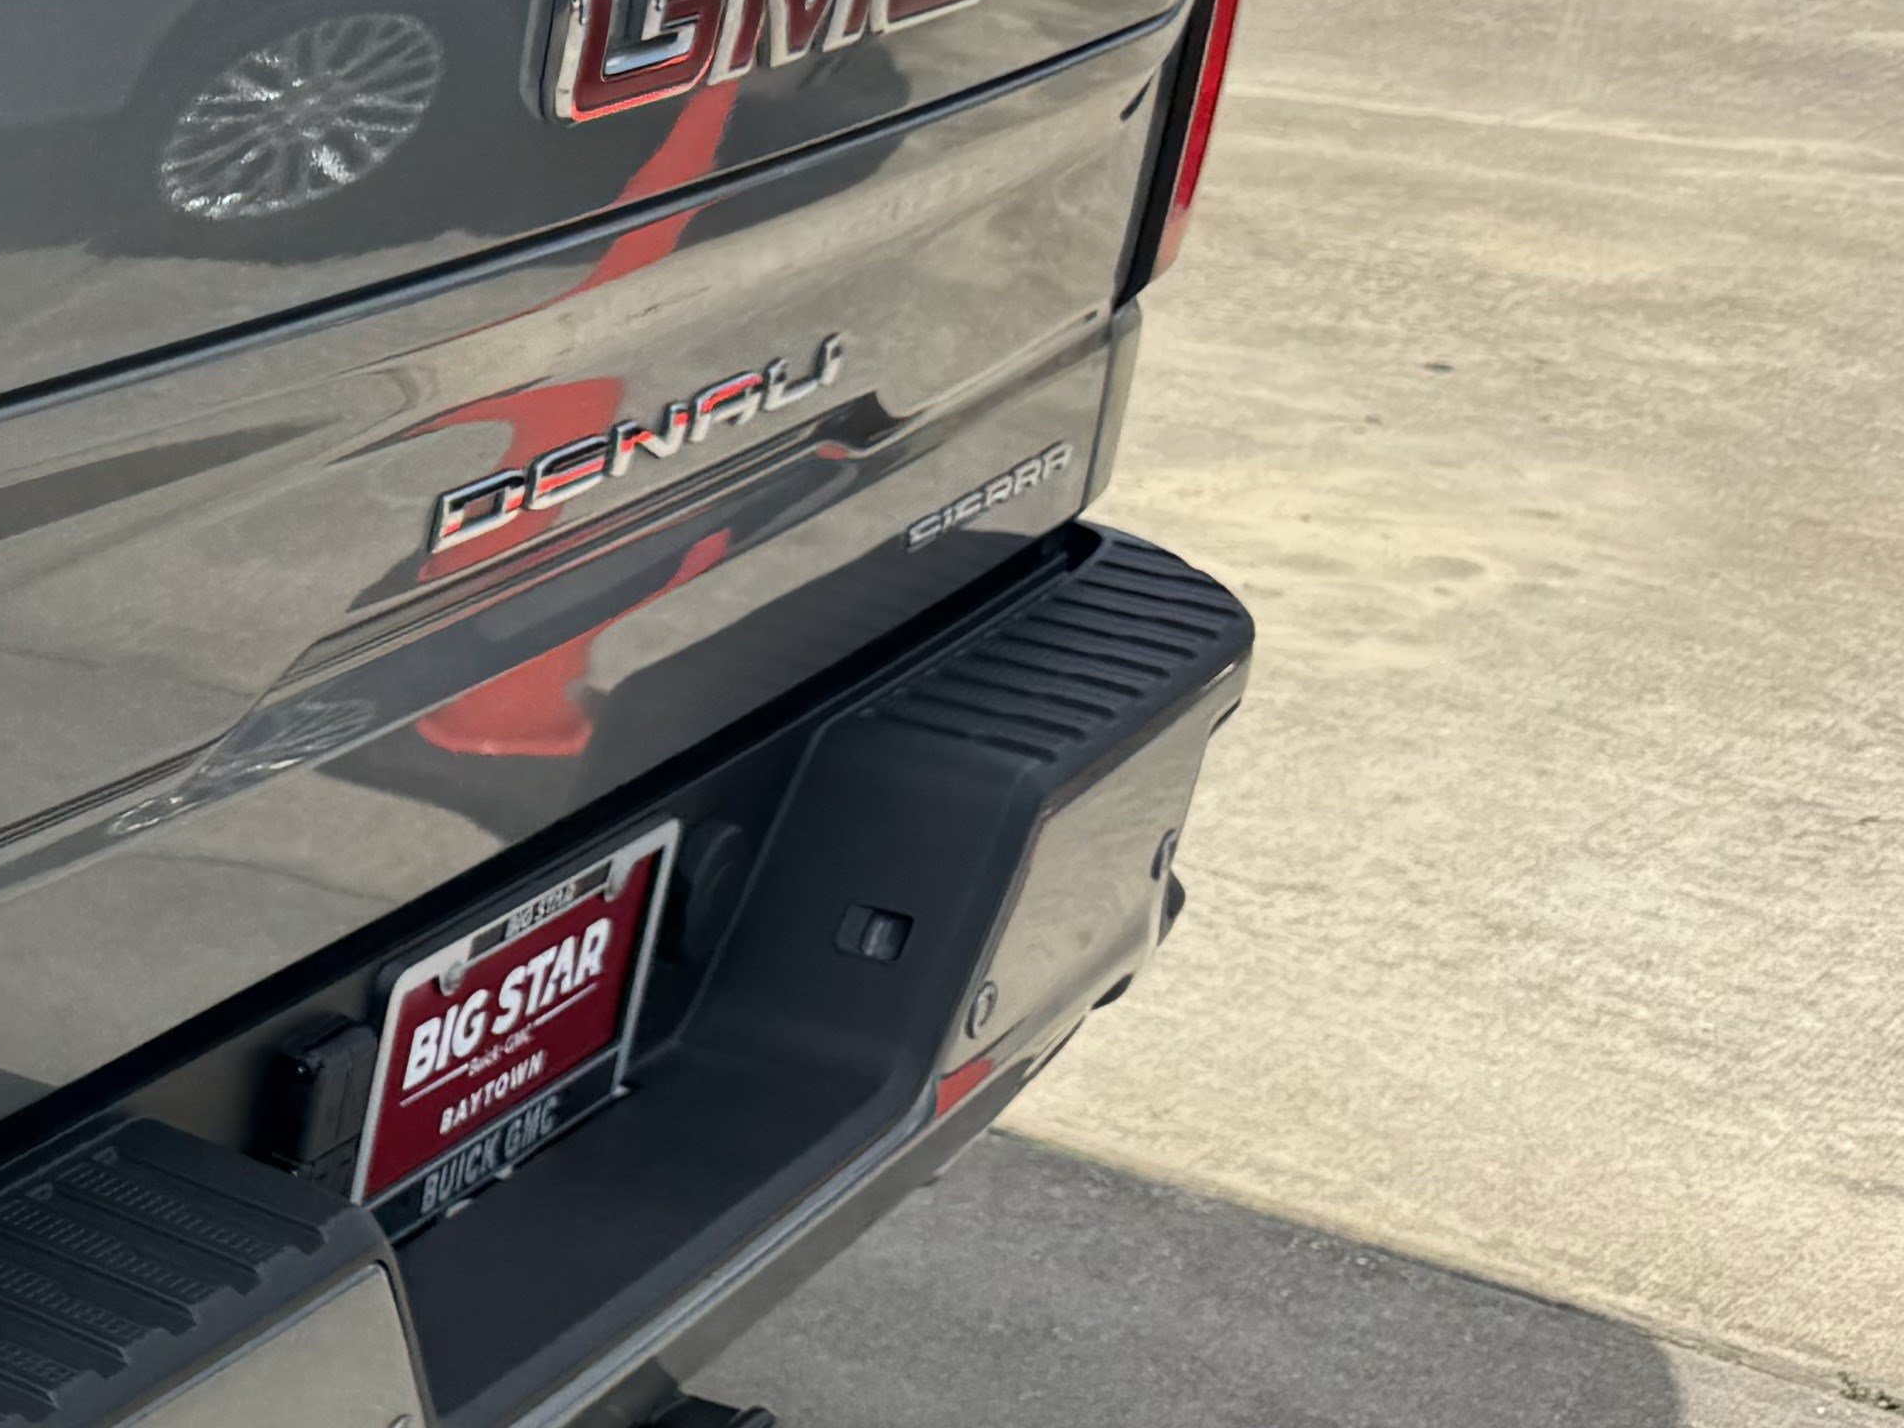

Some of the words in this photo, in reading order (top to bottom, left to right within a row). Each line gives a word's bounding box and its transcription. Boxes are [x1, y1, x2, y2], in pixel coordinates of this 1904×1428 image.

[428, 330, 844, 555] DENALI
[905, 439, 1074, 554] SIERRA
[402, 988, 490, 1091] BIG
[491, 917, 613, 1035] STAR
[439, 1049, 547, 1135] BAYTOWN
[419, 1126, 502, 1216] BUICK
[503, 1095, 560, 1159] GMC
